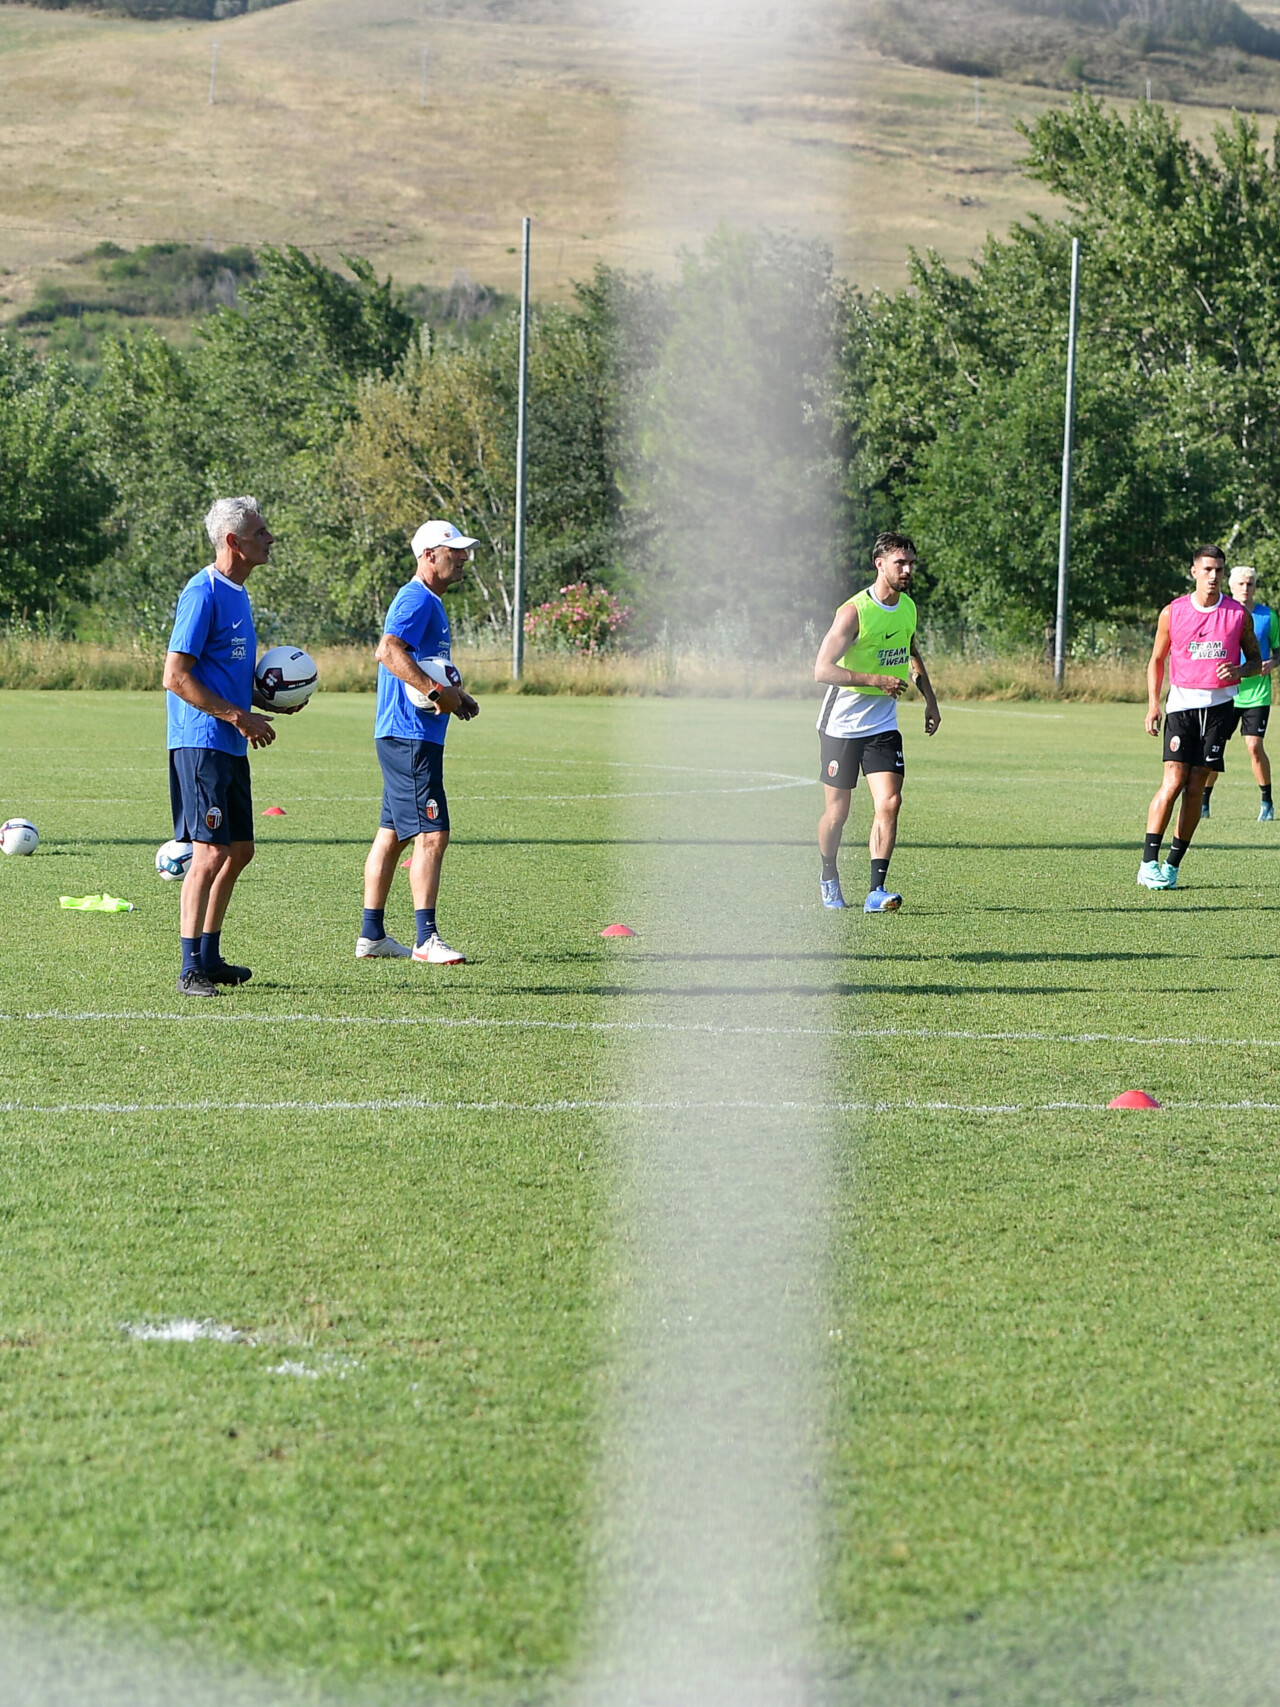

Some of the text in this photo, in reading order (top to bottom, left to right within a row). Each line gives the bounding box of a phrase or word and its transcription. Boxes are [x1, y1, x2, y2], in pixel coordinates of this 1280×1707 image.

[883, 647, 907, 657] TEAM
[1199, 650, 1227, 658] WEAR
[885, 656, 910, 666] WEAR
